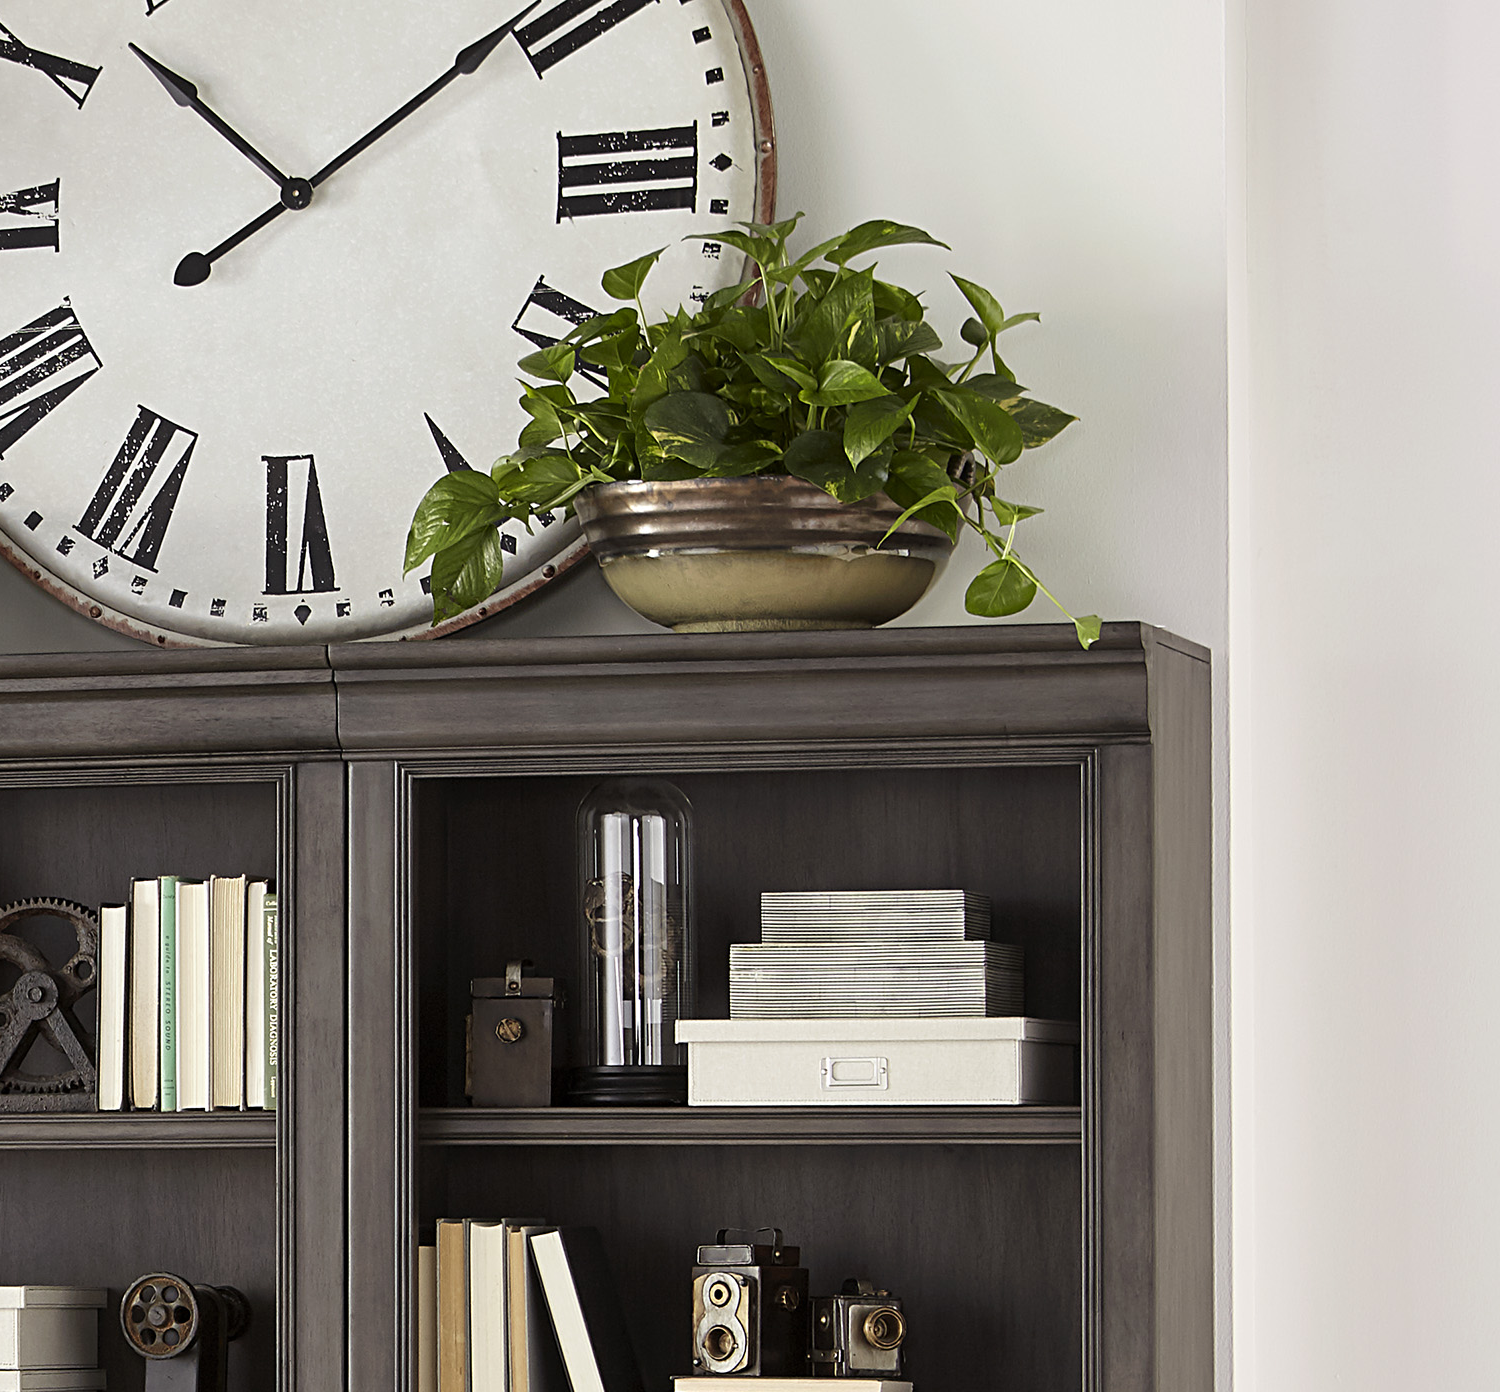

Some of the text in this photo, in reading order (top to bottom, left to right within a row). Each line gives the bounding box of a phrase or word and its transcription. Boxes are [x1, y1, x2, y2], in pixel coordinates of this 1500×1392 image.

[556, 119, 698, 225] III
[74, 404, 199, 573] VII
[260, 453, 341, 597] VI
[269, 949, 278, 1012] LABORATORY
[269, 1014, 278, 1066] DIAGNOSIS
